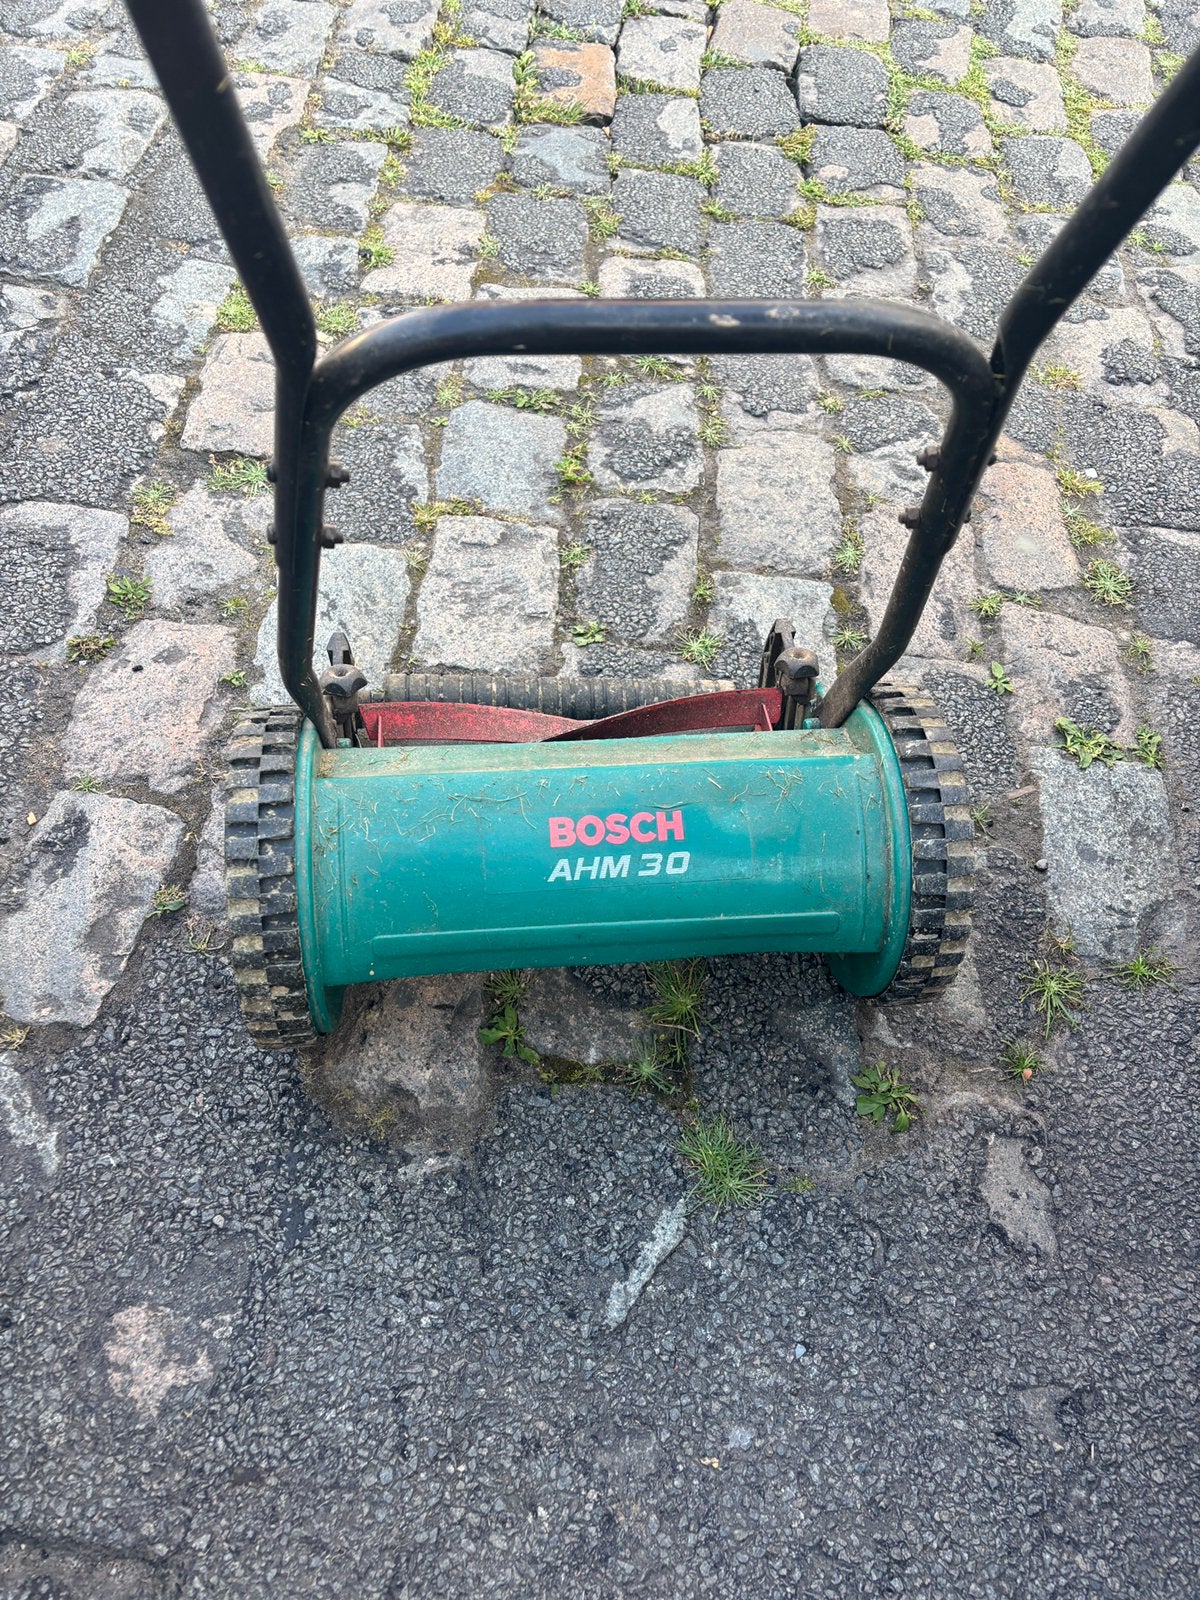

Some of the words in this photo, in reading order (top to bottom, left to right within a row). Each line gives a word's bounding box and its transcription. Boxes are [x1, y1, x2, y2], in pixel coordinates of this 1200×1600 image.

[548, 810, 685, 848] BOSCH
[547, 855, 631, 883] AHM
[638, 851, 691, 877] 30
